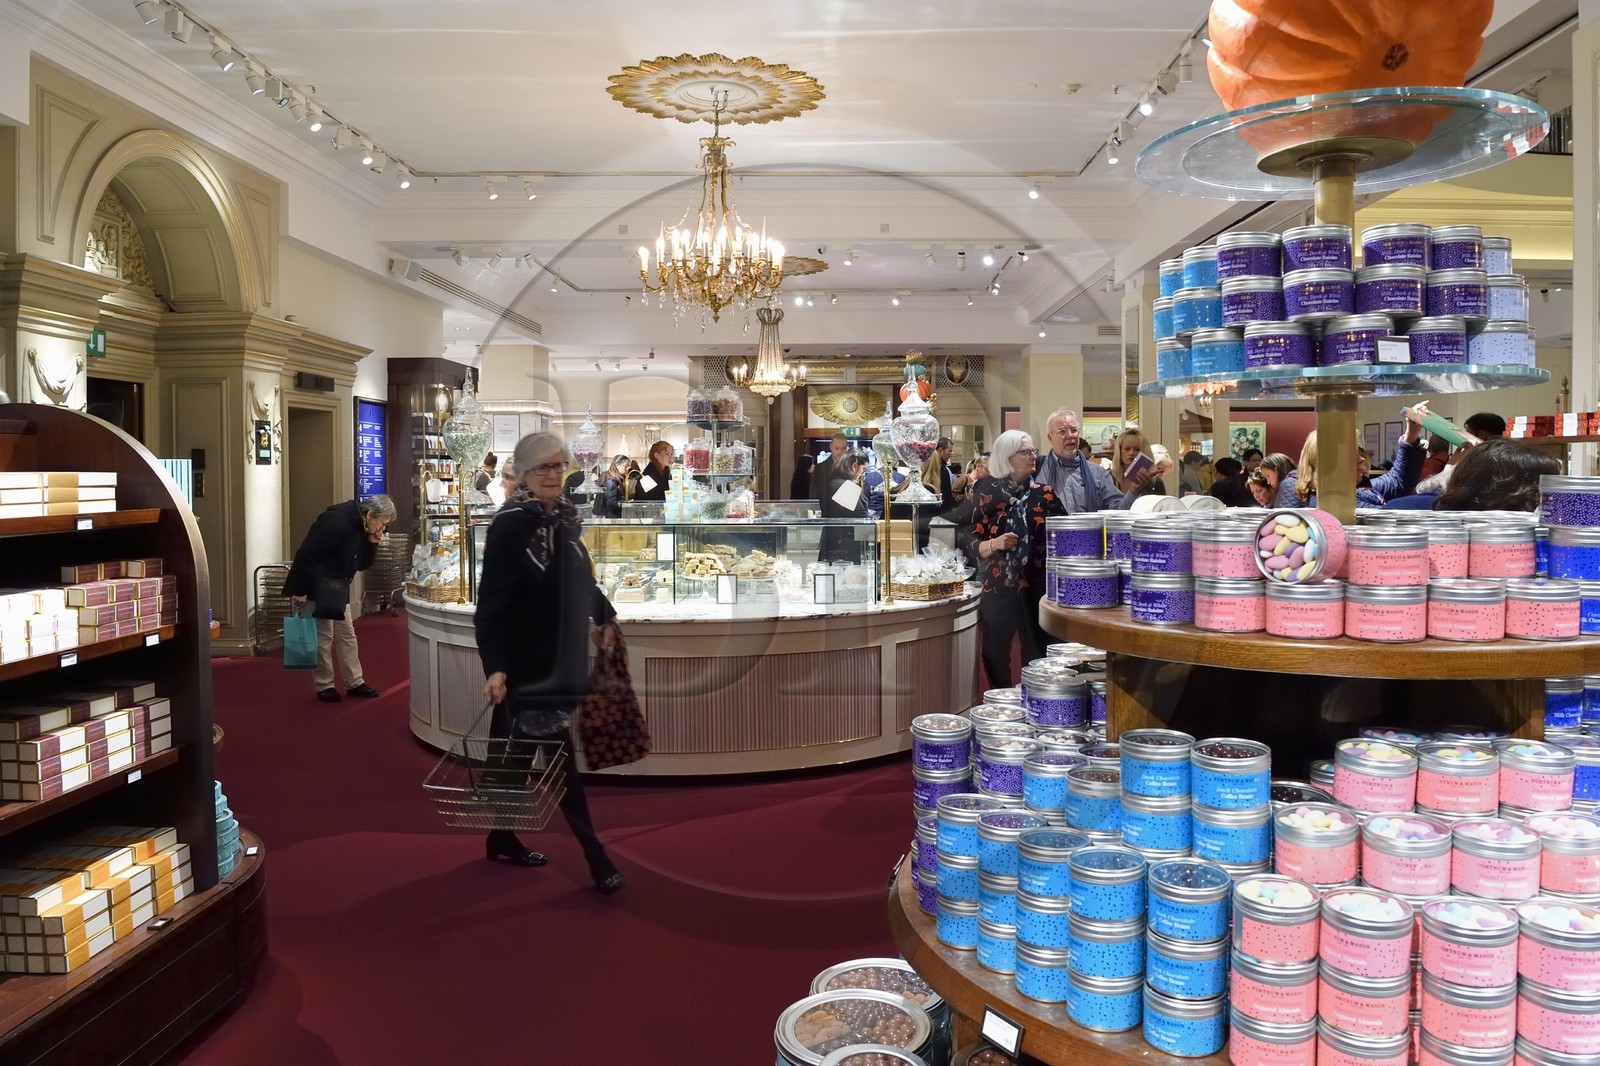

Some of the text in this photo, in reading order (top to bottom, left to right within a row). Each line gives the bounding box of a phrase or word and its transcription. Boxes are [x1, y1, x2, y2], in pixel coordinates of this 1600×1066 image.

[1168, 914, 1196, 924] Chocolate
[1174, 922, 1191, 930] Beans
[1350, 941, 1370, 949] MASON
[1561, 955, 1589, 963] FORTNUM
[1169, 977, 1185, 986] Beans
[1252, 986, 1281, 997] FORTNUM
[1457, 1011, 1488, 1020] FORTNUM
[1560, 1018, 1589, 1026] FORTNUM
[1257, 1045, 1285, 1054] FORTNUM
